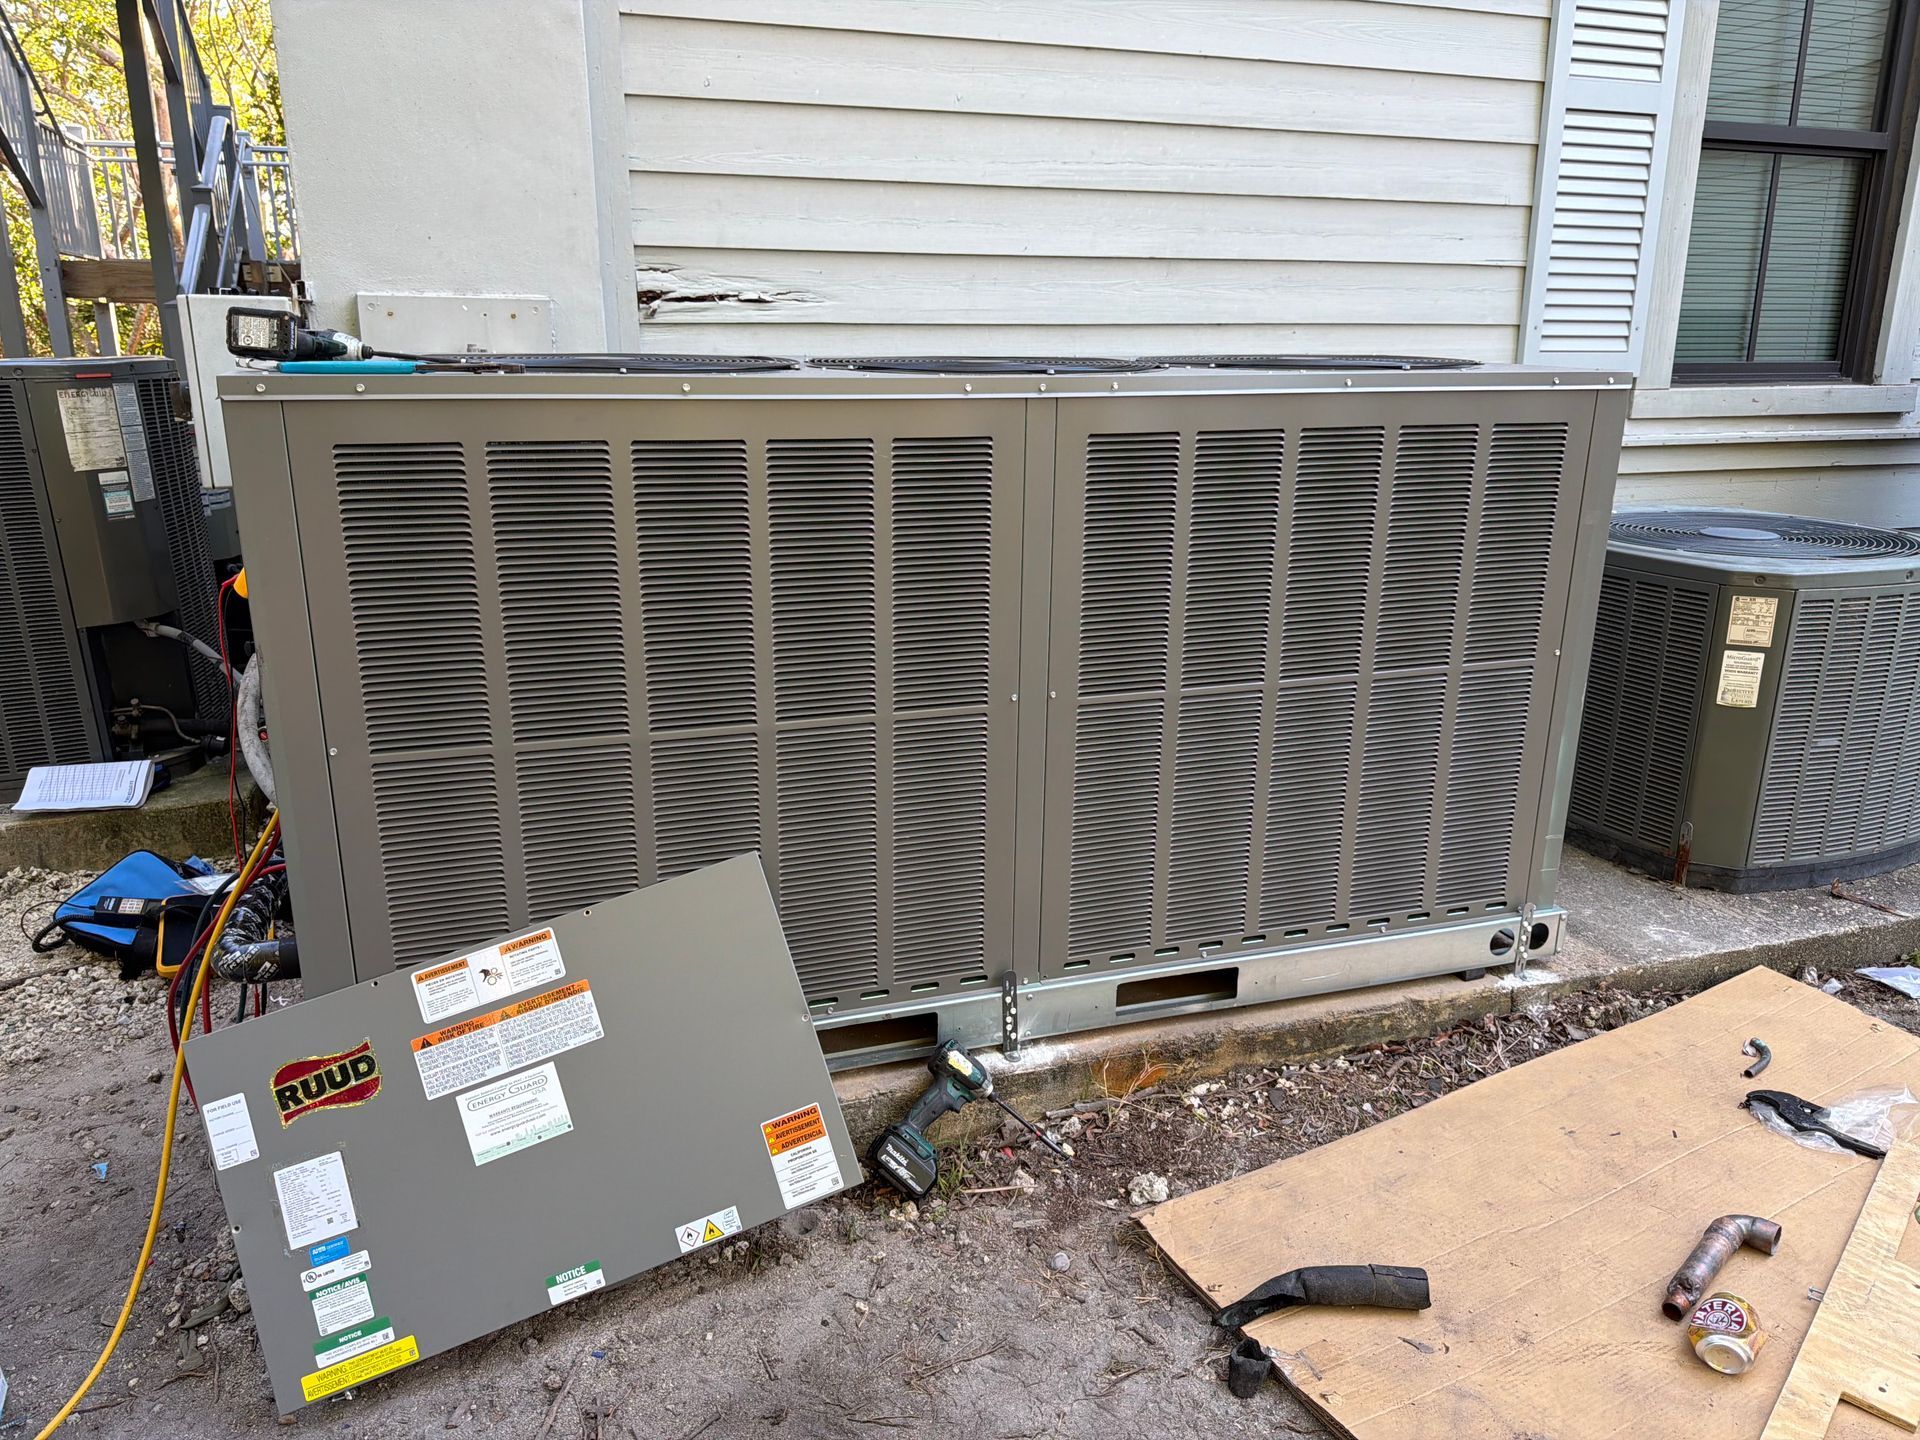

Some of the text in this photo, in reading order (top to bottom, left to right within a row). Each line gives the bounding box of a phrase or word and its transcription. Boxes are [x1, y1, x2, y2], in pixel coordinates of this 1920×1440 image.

[511, 932, 547, 950] WARNING
[423, 959, 465, 979] AVERTISSEMENT
[517, 985, 575, 1009] AVERTISSEMENT
[515, 1001, 544, 1015] RISQUE
[437, 1021, 485, 1042] RISK OF FIRE
[439, 1021, 470, 1036] WARNING
[275, 1055, 377, 1111] RUUD
[471, 1090, 506, 1109] ENERGY
[507, 1073, 545, 1095] GUARD
[531, 1086, 546, 1096] USA
[217, 1102, 231, 1110] FIELD
[771, 1107, 817, 1129] WARNING
[774, 1117, 821, 1140] AVERTISSEMENT
[780, 1128, 822, 1149] ADVERTENCIA
[886, 1143, 909, 1167] makita
[555, 1265, 586, 1283] NOTICE
[315, 1276, 360, 1297] NOTICE/AVIS
[338, 1329, 362, 1343] NOTICE
